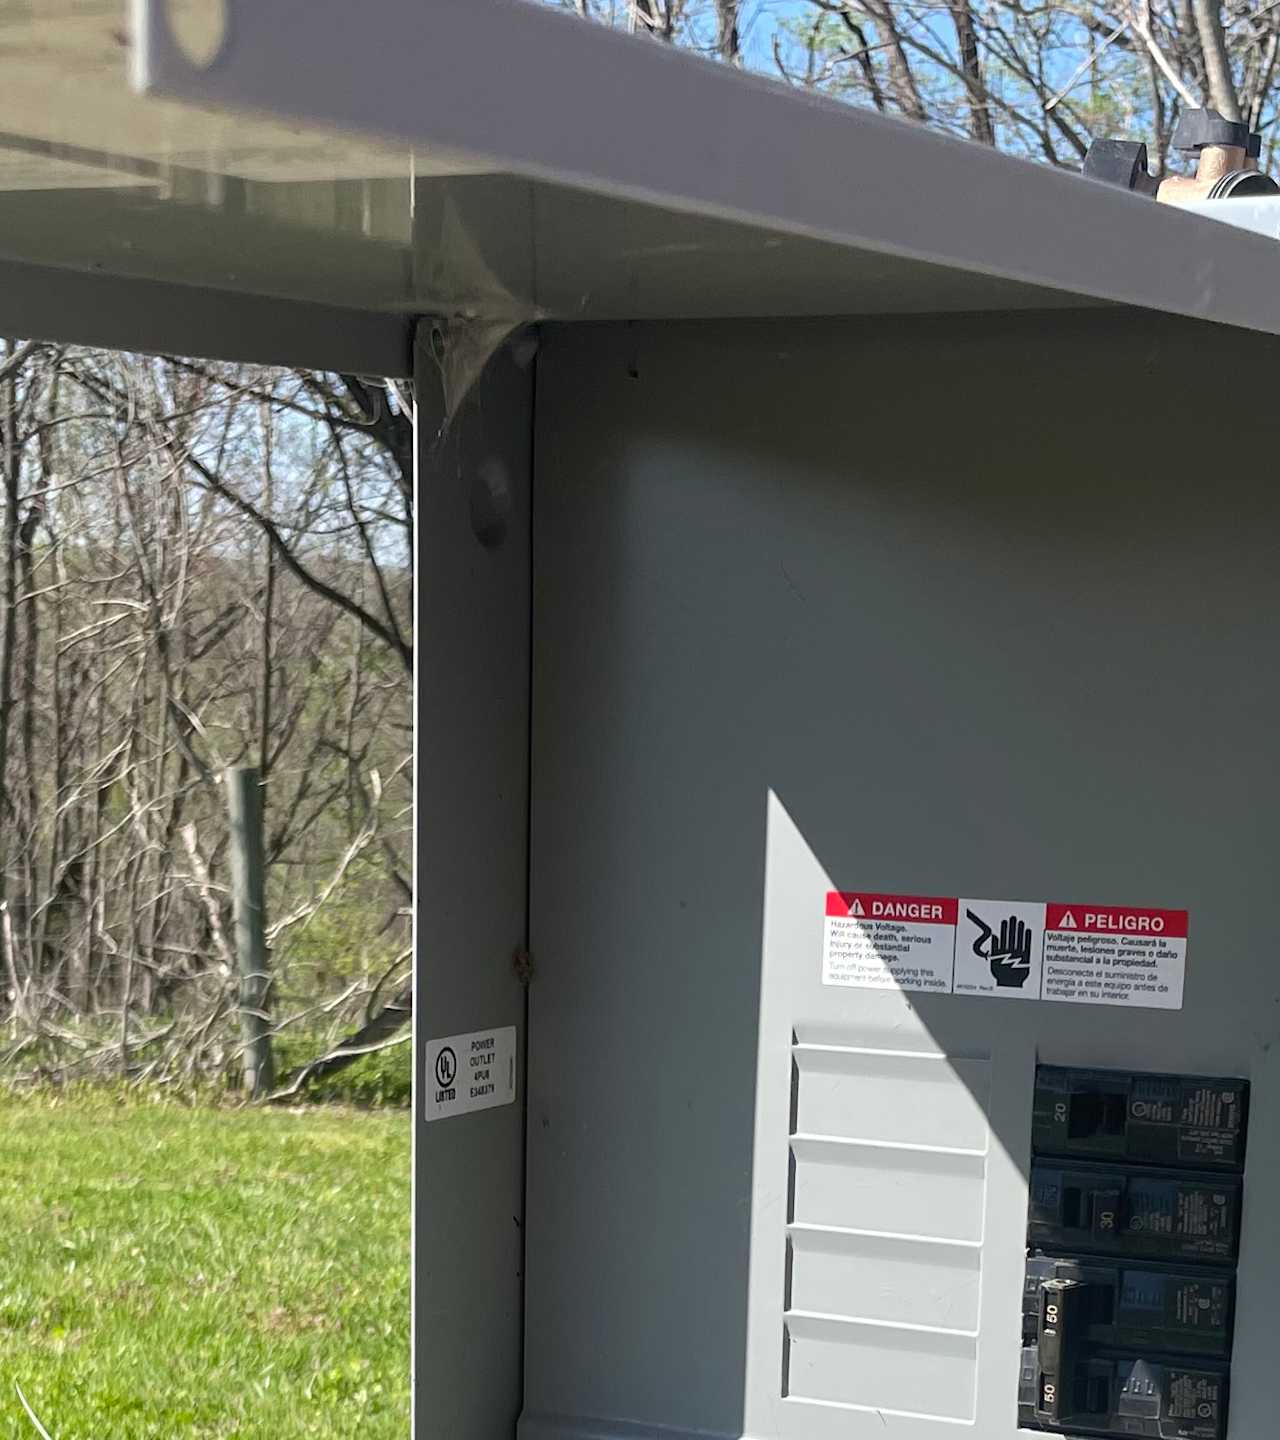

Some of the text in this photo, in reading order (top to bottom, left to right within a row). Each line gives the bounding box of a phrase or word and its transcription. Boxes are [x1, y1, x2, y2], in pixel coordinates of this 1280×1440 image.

[871, 901, 943, 919] DANGER
[875, 922, 908, 933] Voltage.
[1084, 912, 1165, 932] PELIGRO
[873, 932, 899, 942] death,
[901, 935, 932, 944] serious
[1047, 932, 1167, 948] Voltaje peligroso. Causará la
[1046, 944, 1079, 954] muerte,
[1081, 945, 1115, 955] lesiones
[1117, 948, 1146, 958] graves
[1156, 950, 1178, 960] daño
[1046, 954, 1094, 964] substancial
[1103, 956, 1111, 965] la
[1112, 958, 1158, 969] propiedad.
[883, 966, 919, 977] pplying
[1104, 970, 1146, 981] suministro
[1147, 972, 1158, 981] de
[471, 1037, 495, 1052] POWER
[440, 1055, 452, 1079] UL
[469, 1053, 495, 1067] OUTLET
[435, 1087, 456, 1104] LISTED
[1054, 1102, 1066, 1122] 20
[1100, 1211, 1114, 1229] 30
[1046, 1304, 1059, 1324] 50
[1043, 1383, 1056, 1403] 50
